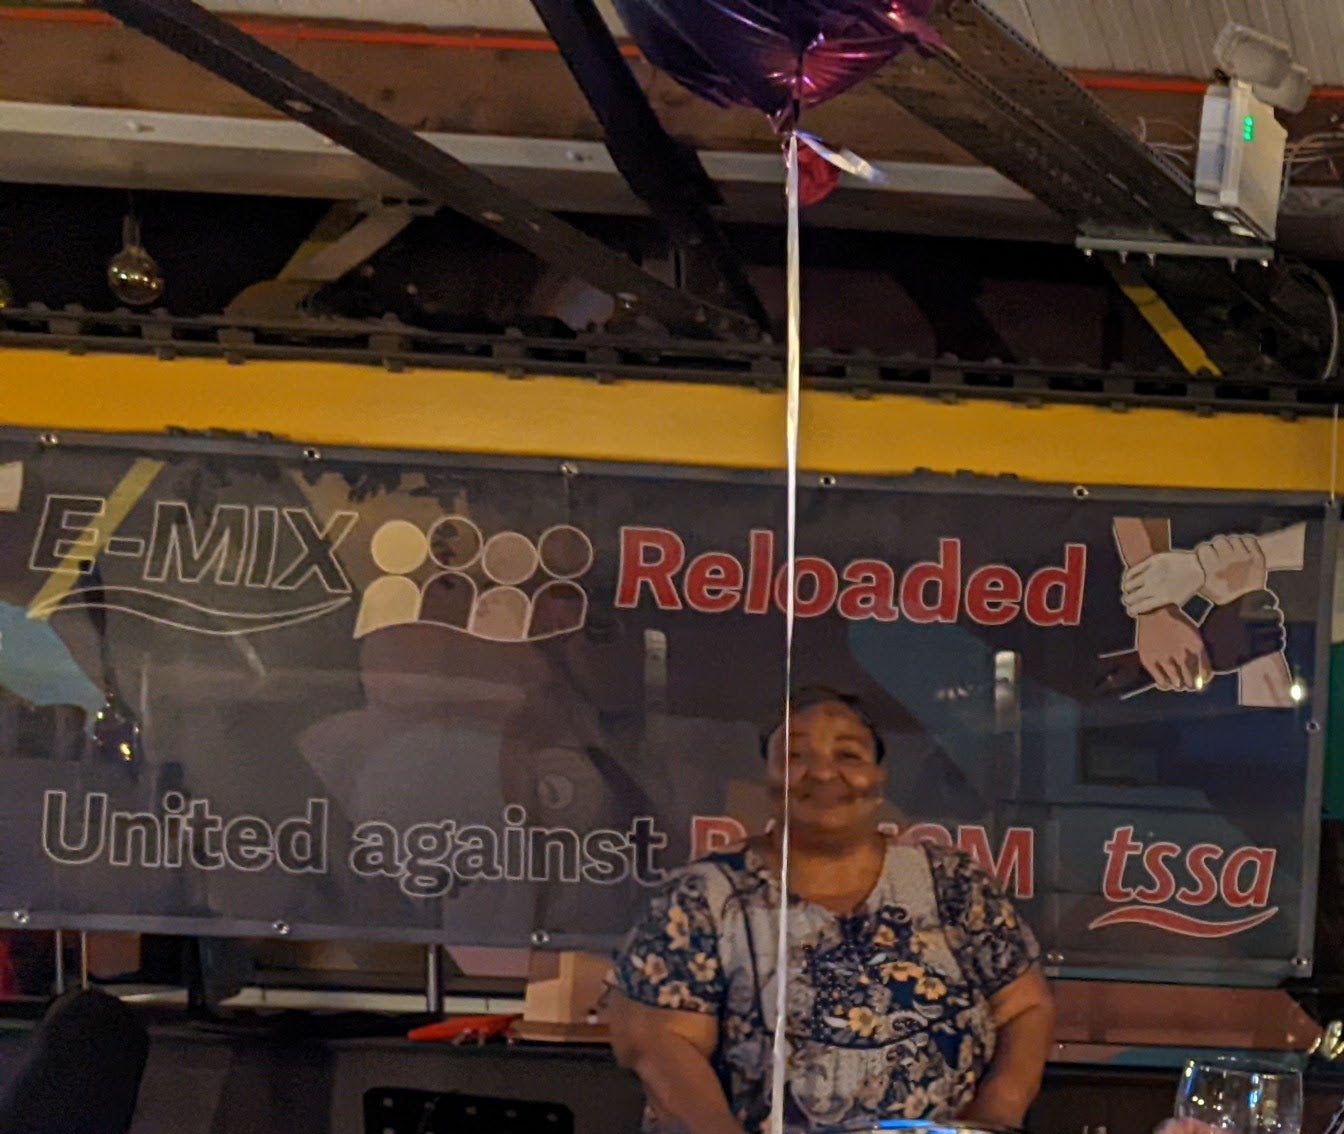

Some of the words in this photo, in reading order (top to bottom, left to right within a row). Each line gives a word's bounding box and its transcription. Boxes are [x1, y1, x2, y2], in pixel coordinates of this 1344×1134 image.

[28, 493, 359, 595] E-MIX
[614, 526, 1088, 628] Reloaded
[42, 790, 328, 875] United
[348, 804, 667, 898] against
[1102, 824, 1278, 908] tssa
